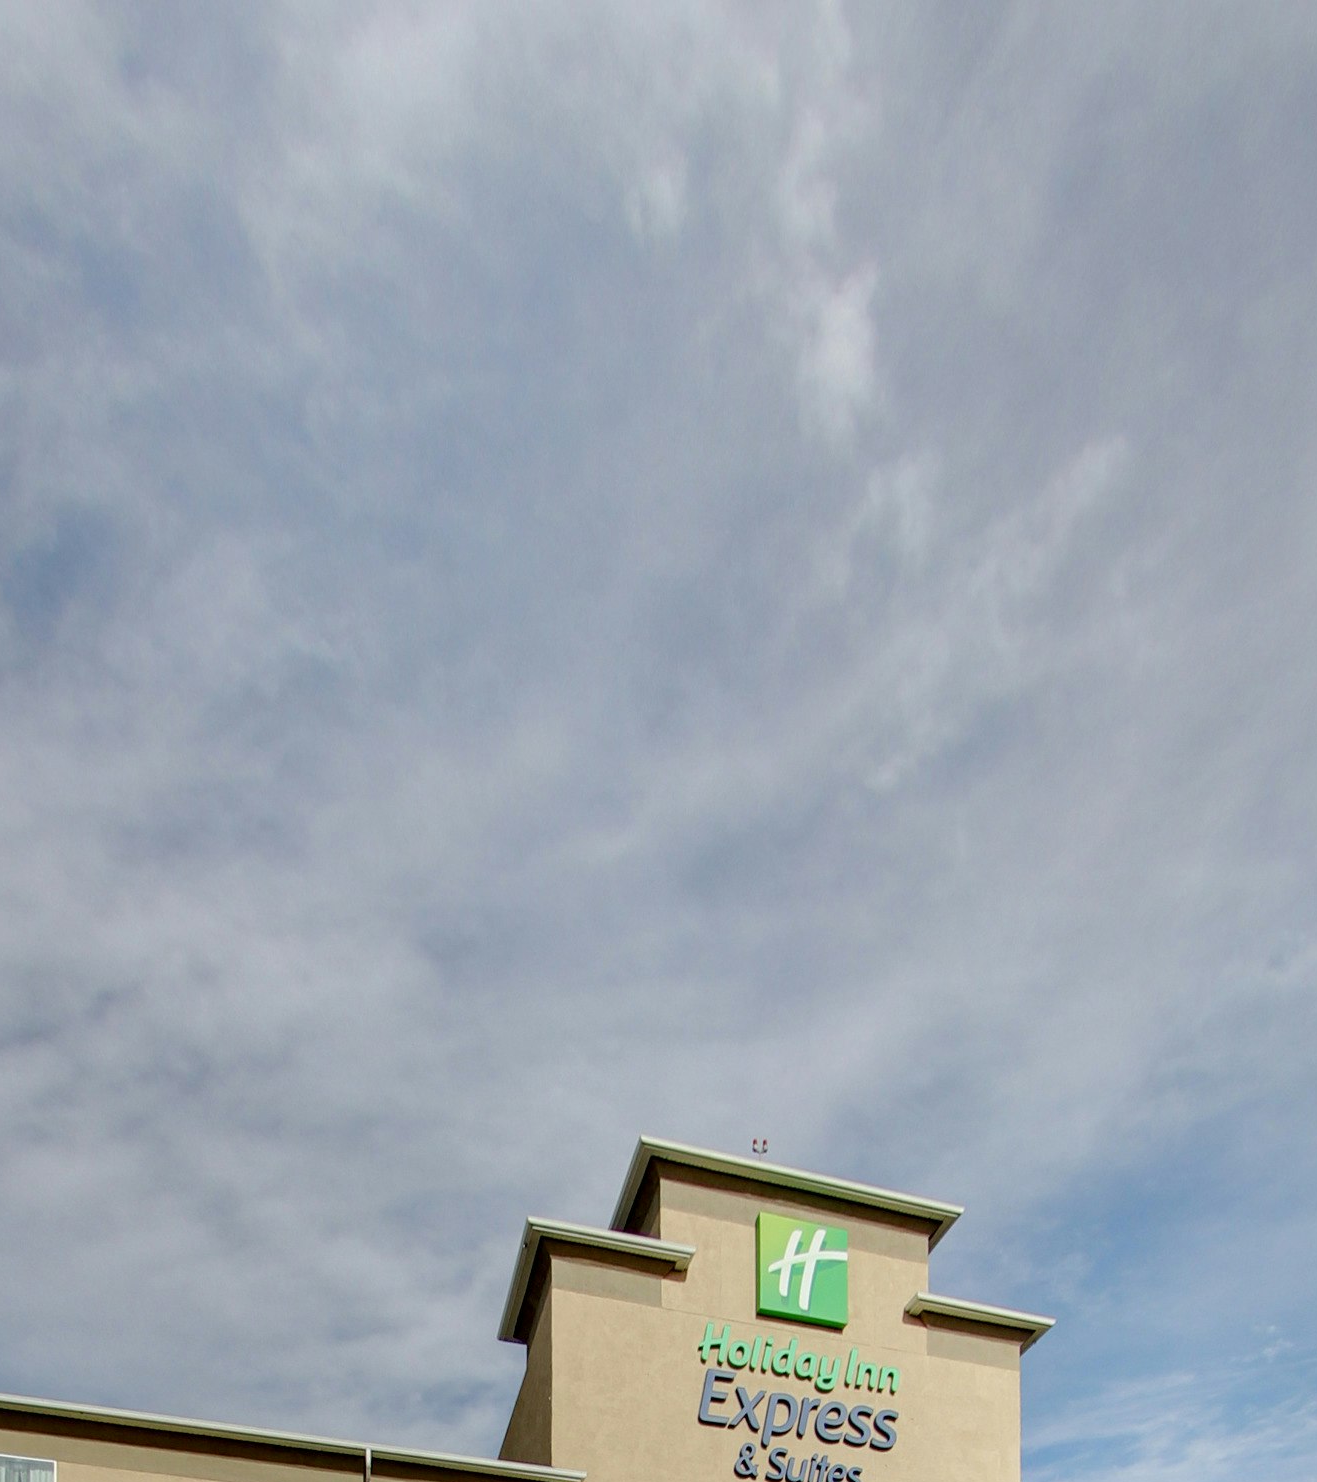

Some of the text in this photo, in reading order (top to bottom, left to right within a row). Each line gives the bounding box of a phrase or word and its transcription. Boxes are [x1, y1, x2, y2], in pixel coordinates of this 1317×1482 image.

[698, 1322, 901, 1393] Holiday Inn
[698, 1368, 899, 1450] Express
[734, 1442, 758, 1478] &
